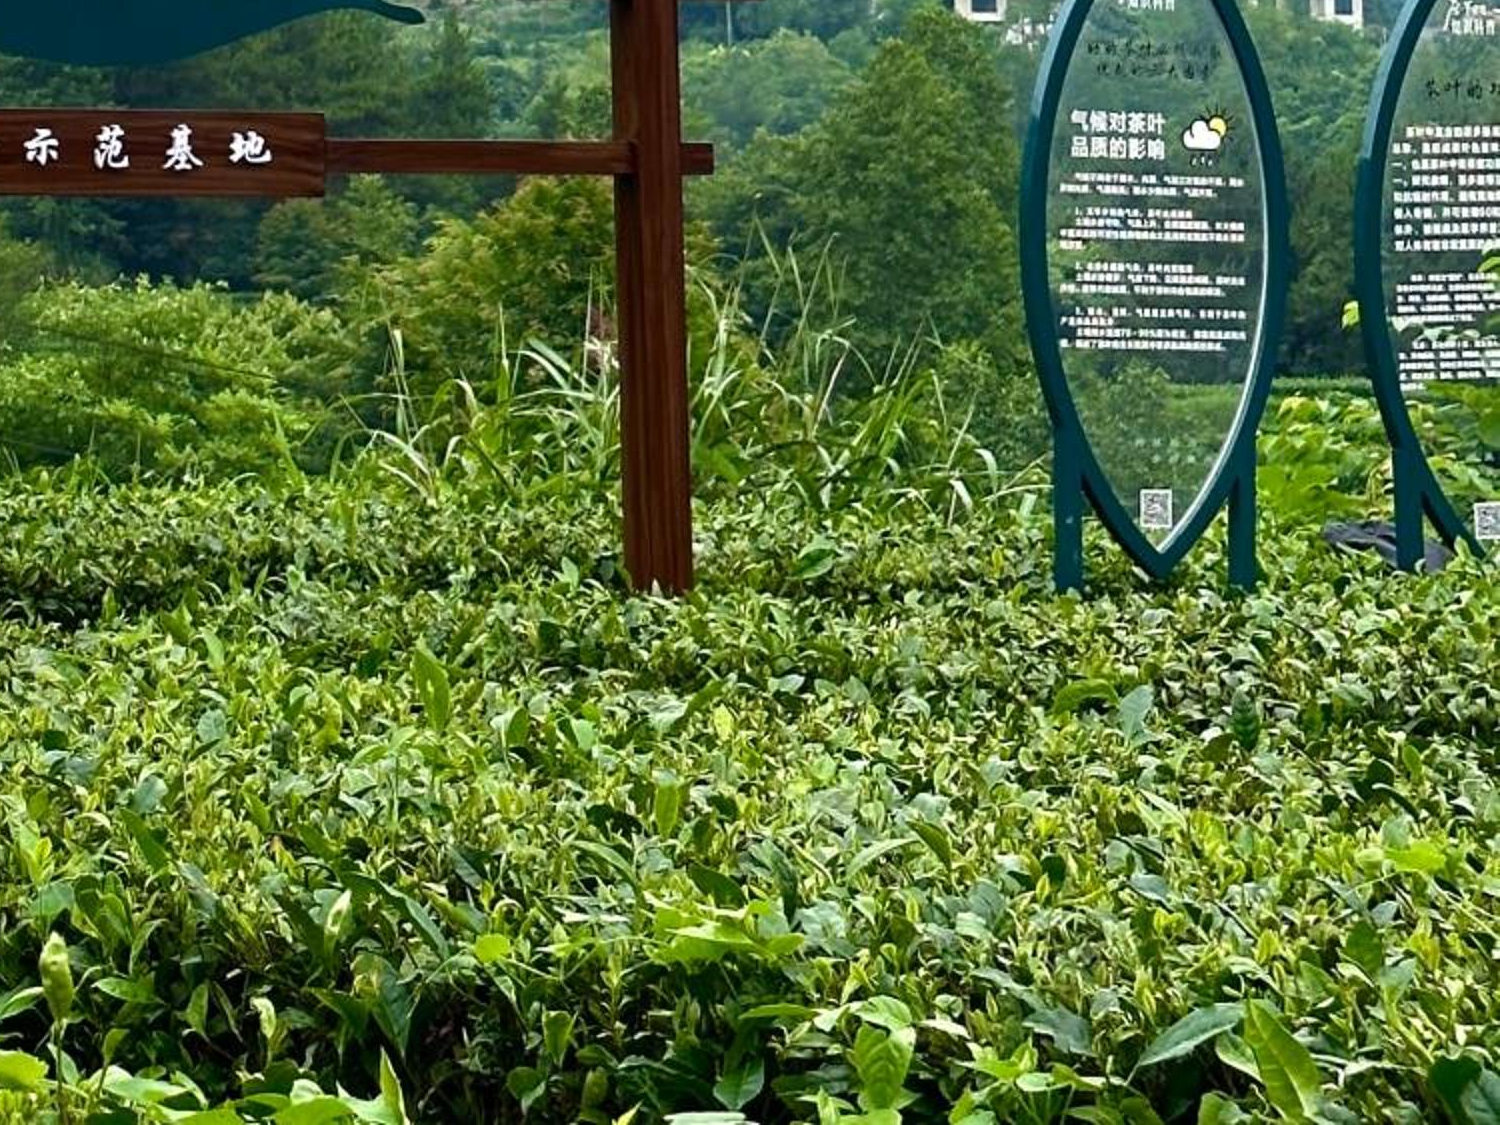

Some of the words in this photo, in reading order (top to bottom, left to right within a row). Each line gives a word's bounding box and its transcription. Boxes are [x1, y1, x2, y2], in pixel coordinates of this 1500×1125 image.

[1071, 109, 1166, 136] 气候对茶叶
[1071, 136, 1166, 161] 品质的影响
